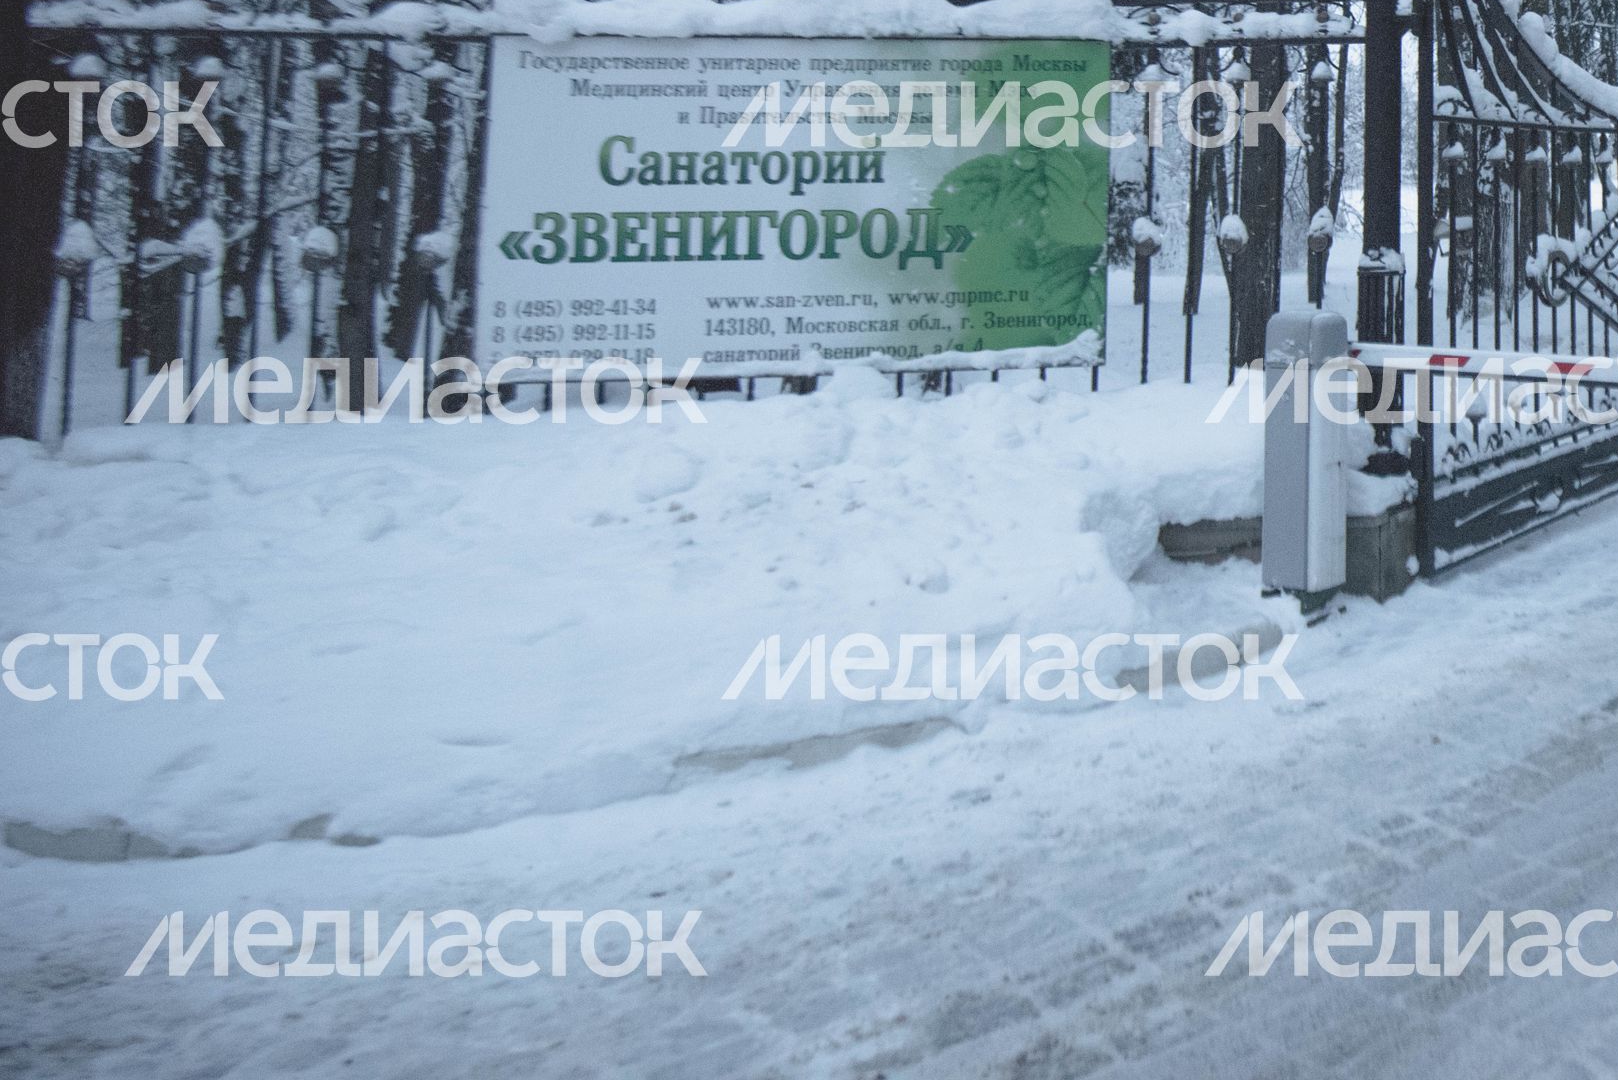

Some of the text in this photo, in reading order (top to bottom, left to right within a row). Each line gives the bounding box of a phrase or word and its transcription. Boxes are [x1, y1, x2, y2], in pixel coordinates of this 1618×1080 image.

[518, 50, 1088, 75] Государственное унитарное предприятие города Москвы
[570, 78, 709, 100] Медицинский
[718, 82, 775, 100] центр
[677, 110, 690, 124] и
[599, 134, 887, 196] Санаторий
[498, 206, 976, 270] «ЗВЕНИГОРОД»
[493, 298, 657, 319] 8 (495) 992-41-34
[705, 293, 878, 308] www.san-zven.ru,
[491, 323, 656, 344] 8 (495) 992-11-15
[705, 317, 776, 337] 143180,
[785, 315, 900, 335] Московская
[908, 313, 952, 332] обл.,
[984, 311, 1094, 330] Звенигород,
